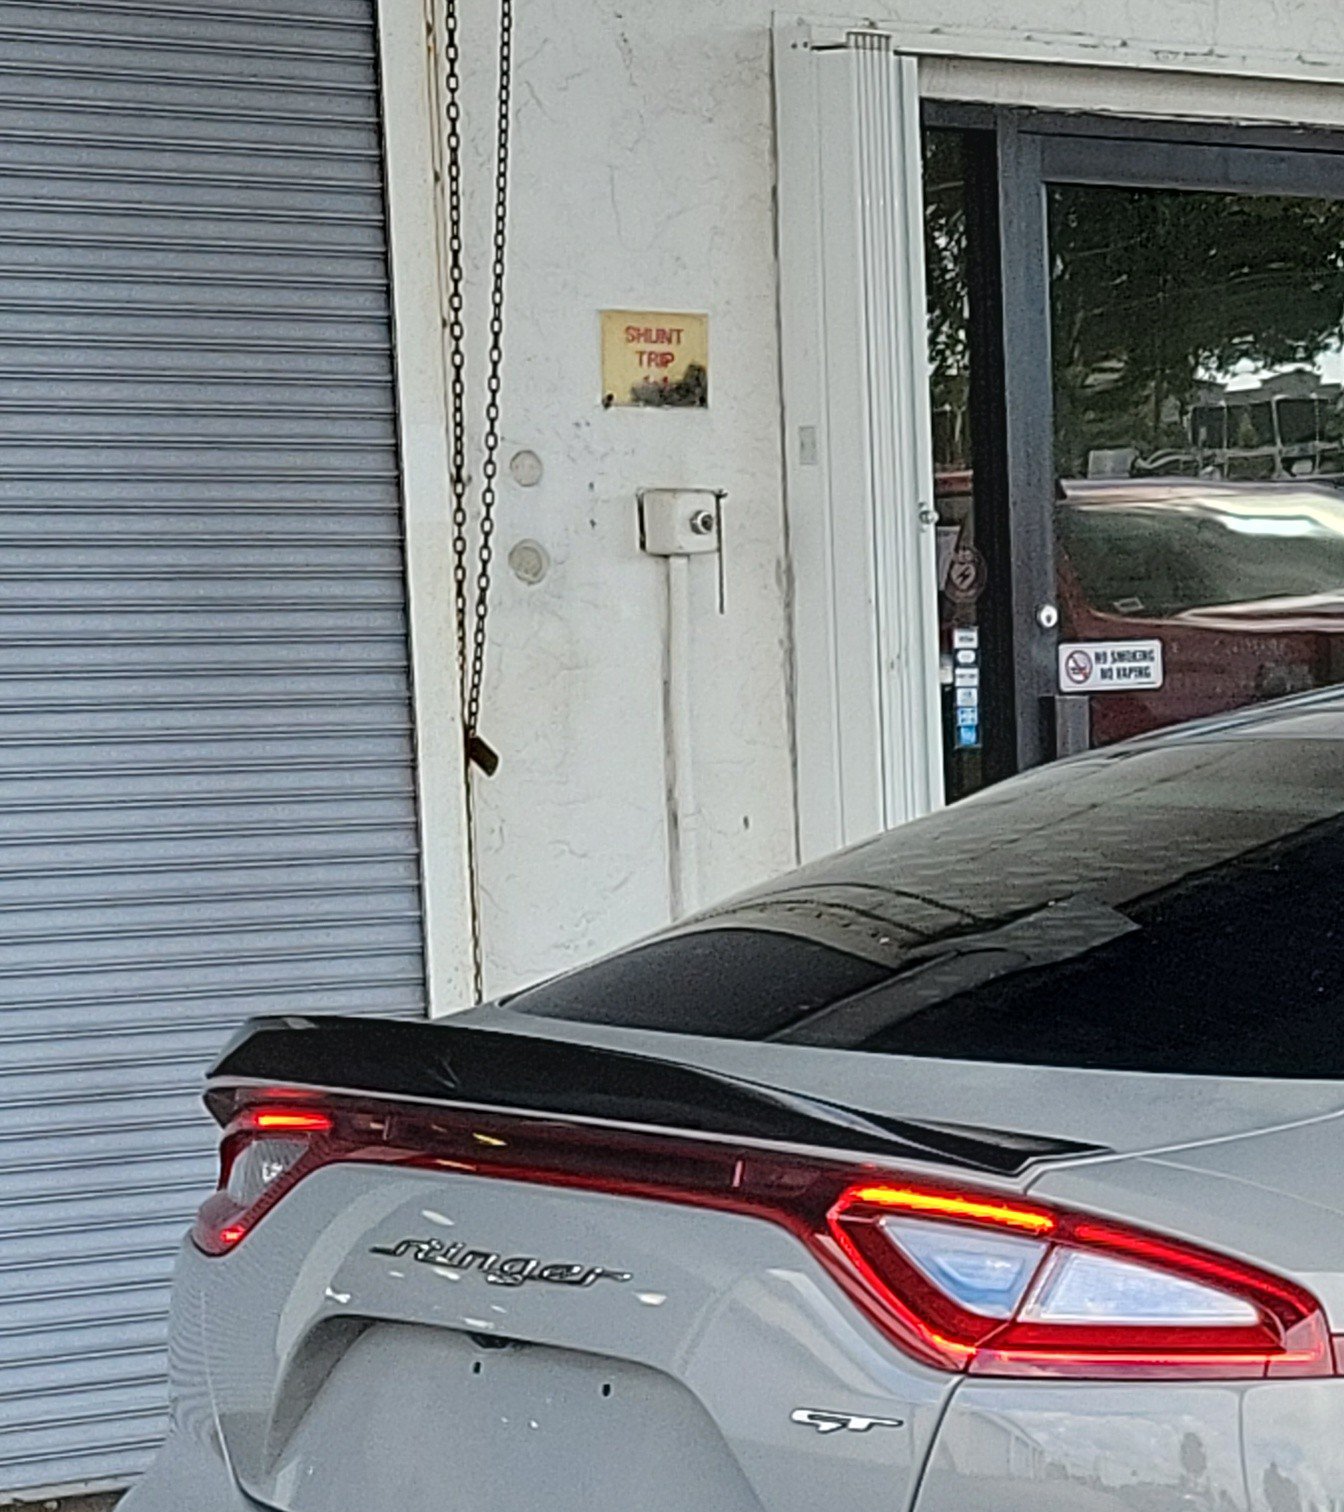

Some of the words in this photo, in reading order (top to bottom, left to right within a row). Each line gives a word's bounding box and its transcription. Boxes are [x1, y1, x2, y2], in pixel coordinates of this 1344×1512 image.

[624, 325, 684, 346] SHUNT
[635, 350, 675, 368] TRIP
[1094, 650, 1107, 665] NO
[1110, 648, 1155, 664] SMOKING
[1100, 667, 1113, 681] NO
[1116, 665, 1151, 680] VAPING
[369, 1238, 634, 1288] Stinger
[789, 1407, 904, 1434] GT
